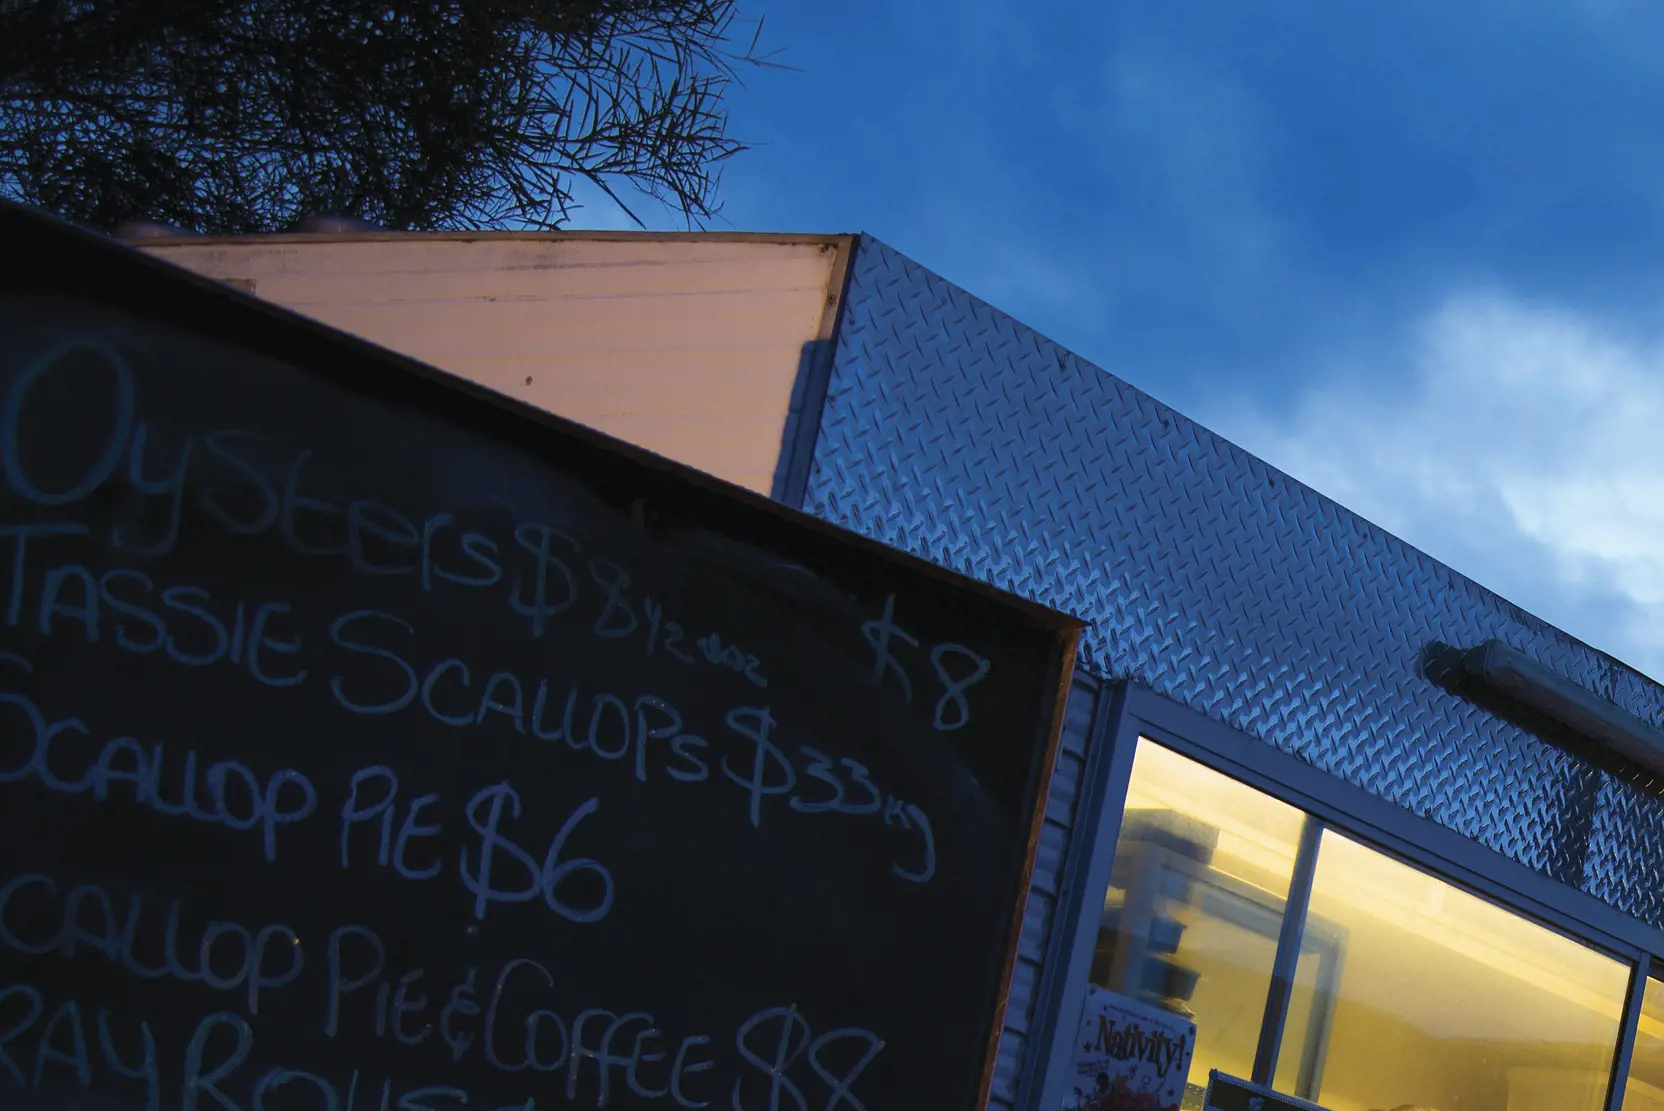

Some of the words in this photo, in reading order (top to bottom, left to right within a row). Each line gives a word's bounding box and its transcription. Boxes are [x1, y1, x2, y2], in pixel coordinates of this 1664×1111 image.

[341, 763, 444, 881] PIE
[458, 778, 616, 923] $6
[325, 923, 433, 1046] PIE
[1094, 1014, 1187, 1079] Nativity!
